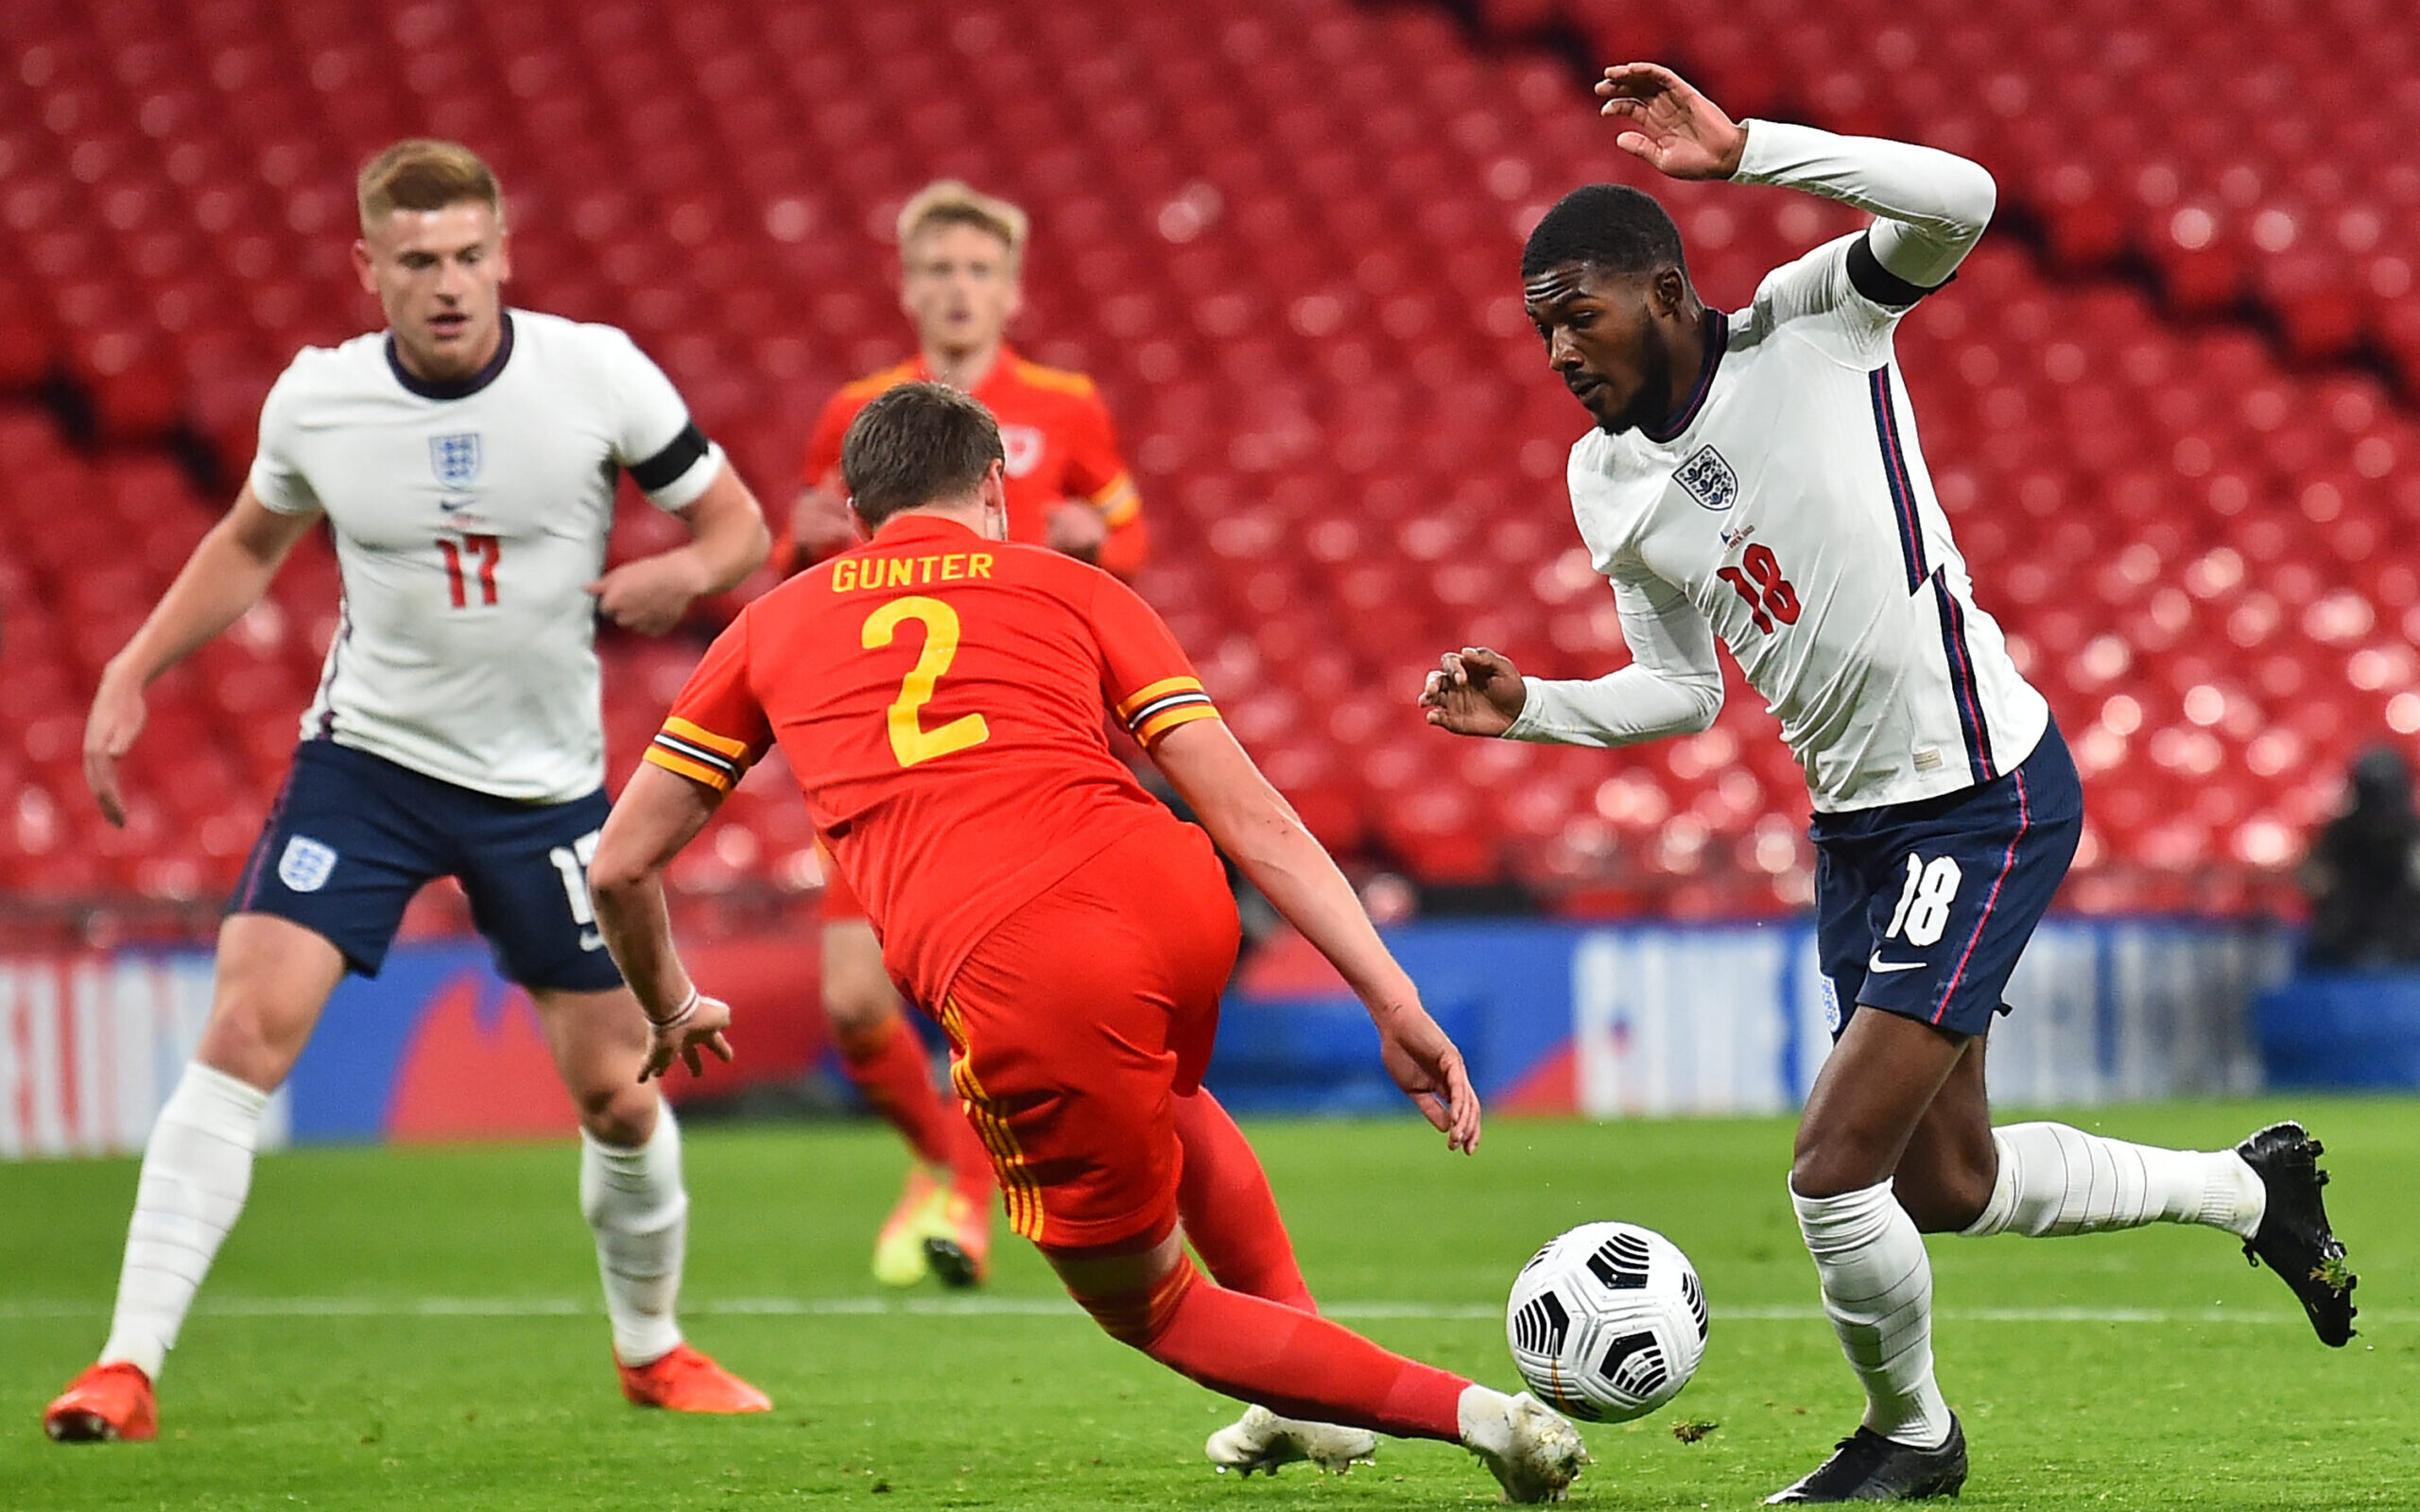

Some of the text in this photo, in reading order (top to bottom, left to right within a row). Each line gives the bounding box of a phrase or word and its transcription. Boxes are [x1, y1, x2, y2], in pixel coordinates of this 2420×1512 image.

[435, 534, 500, 610] 17
[832, 553, 994, 593] GUNTER
[1716, 542, 1802, 635] 18
[861, 595, 990, 768] 2
[1884, 851, 1962, 947] 18
